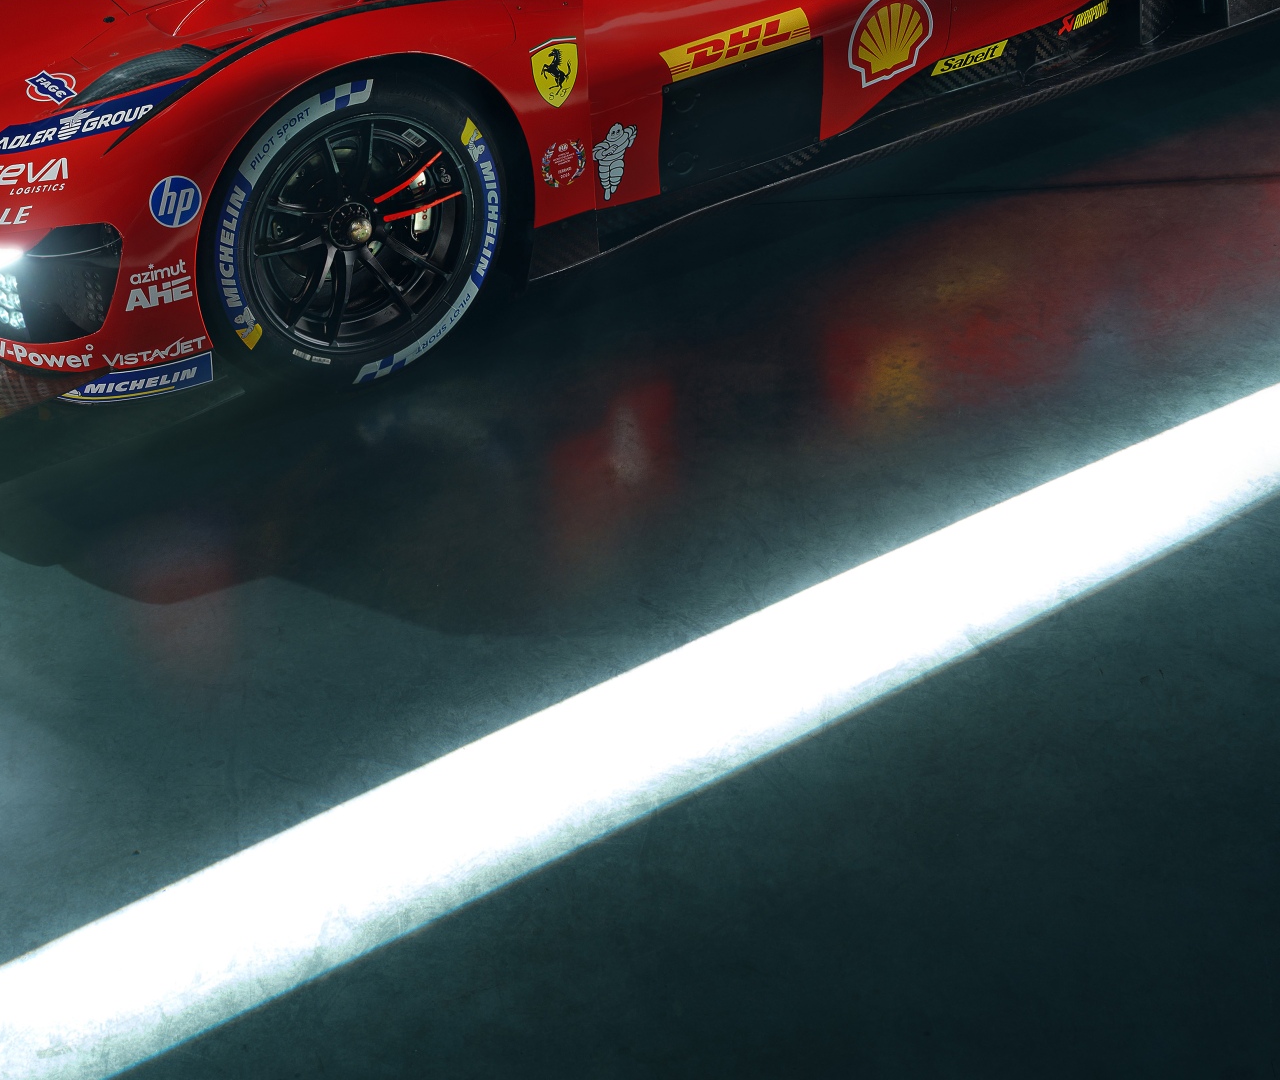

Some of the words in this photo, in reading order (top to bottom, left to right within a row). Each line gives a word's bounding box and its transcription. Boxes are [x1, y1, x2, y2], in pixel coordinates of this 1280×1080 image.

[686, 18, 794, 71] DHL
[940, 45, 999, 72] Sabelt
[35, 76, 68, 99] FAGE
[81, 104, 154, 133] GROUP
[250, 139, 277, 171] PILOT
[276, 107, 311, 139] SPORT
[9, 184, 66, 196] LOGISTICS
[159, 177, 195, 227] hp
[478, 160, 500, 277] MICHELIN
[219, 186, 248, 308] MICHELIN
[130, 259, 187, 285] azimut
[445, 292, 471, 324] PILOT
[102, 335, 207, 367] VISTAJET
[415, 322, 447, 355] SPORT
[83, 366, 198, 394] MICHELIN
